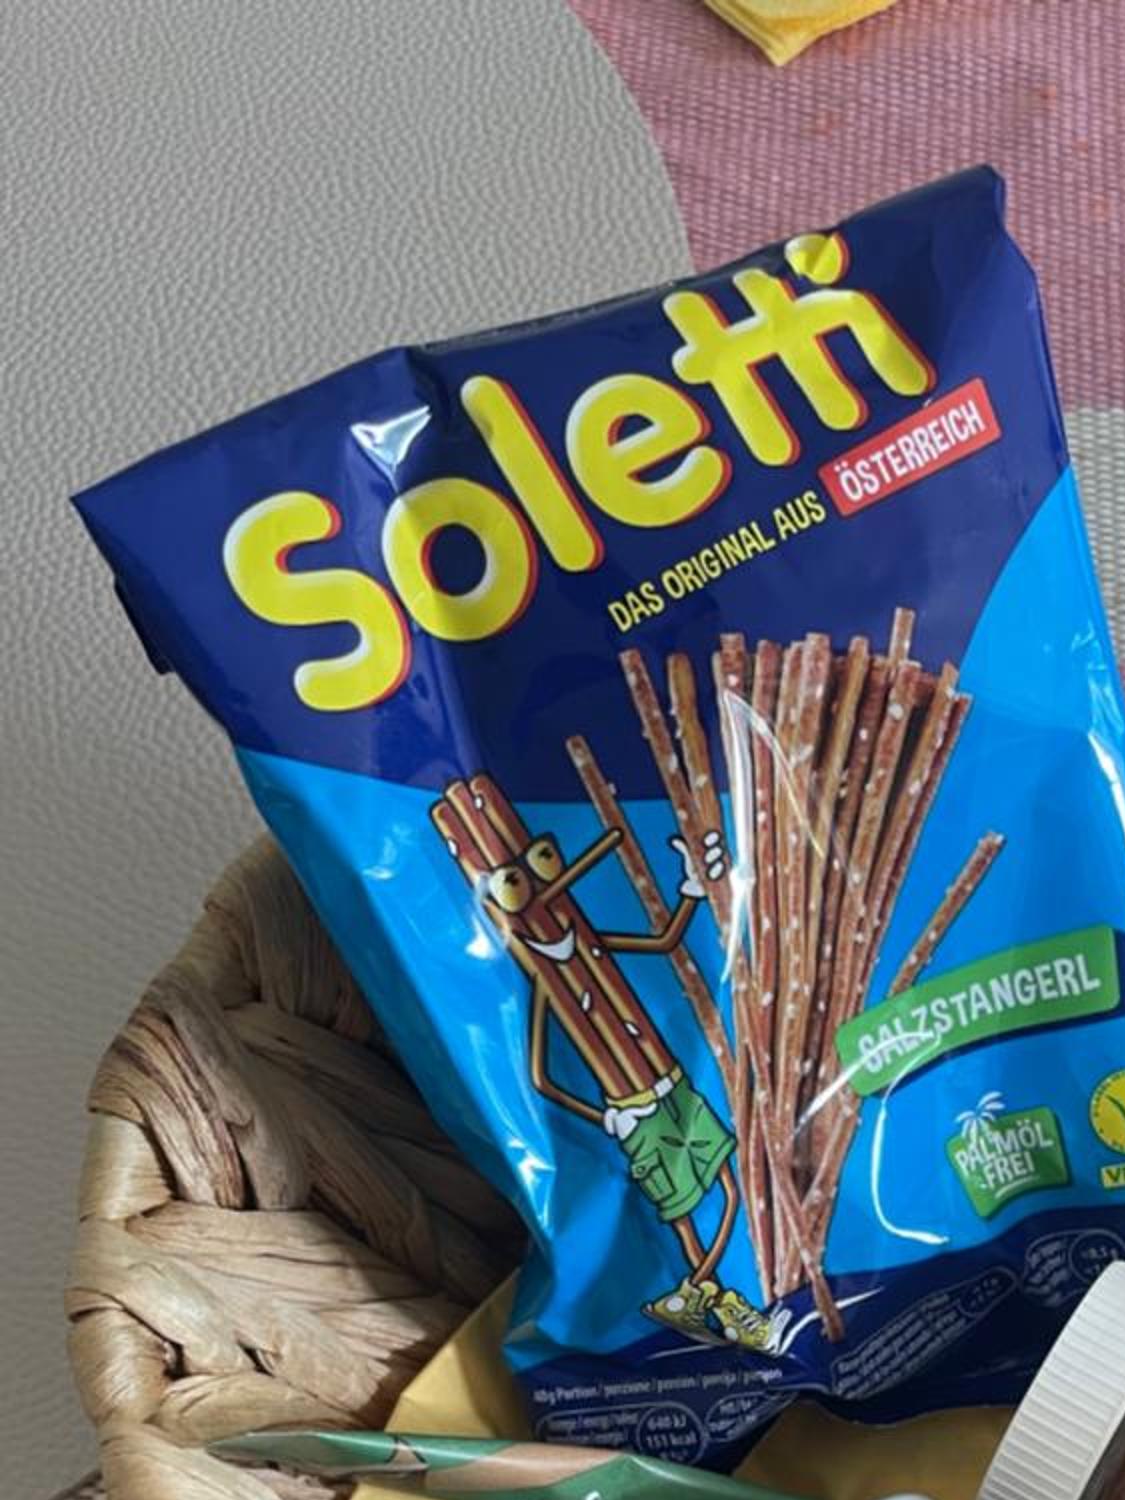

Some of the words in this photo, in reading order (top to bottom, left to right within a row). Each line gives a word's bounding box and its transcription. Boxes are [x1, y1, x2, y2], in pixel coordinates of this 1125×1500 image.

[223, 233, 936, 713] Soletti
[607, 581, 665, 633] DAS
[661, 521, 776, 601] ORIGINAL
[774, 490, 827, 541] AUS
[834, 399, 986, 503] ÖSTERREICH
[857, 953, 1101, 1074] SALZSTANGERL
[954, 1119, 1054, 1177] PALMÖL
[984, 1151, 1036, 1189] FREI
